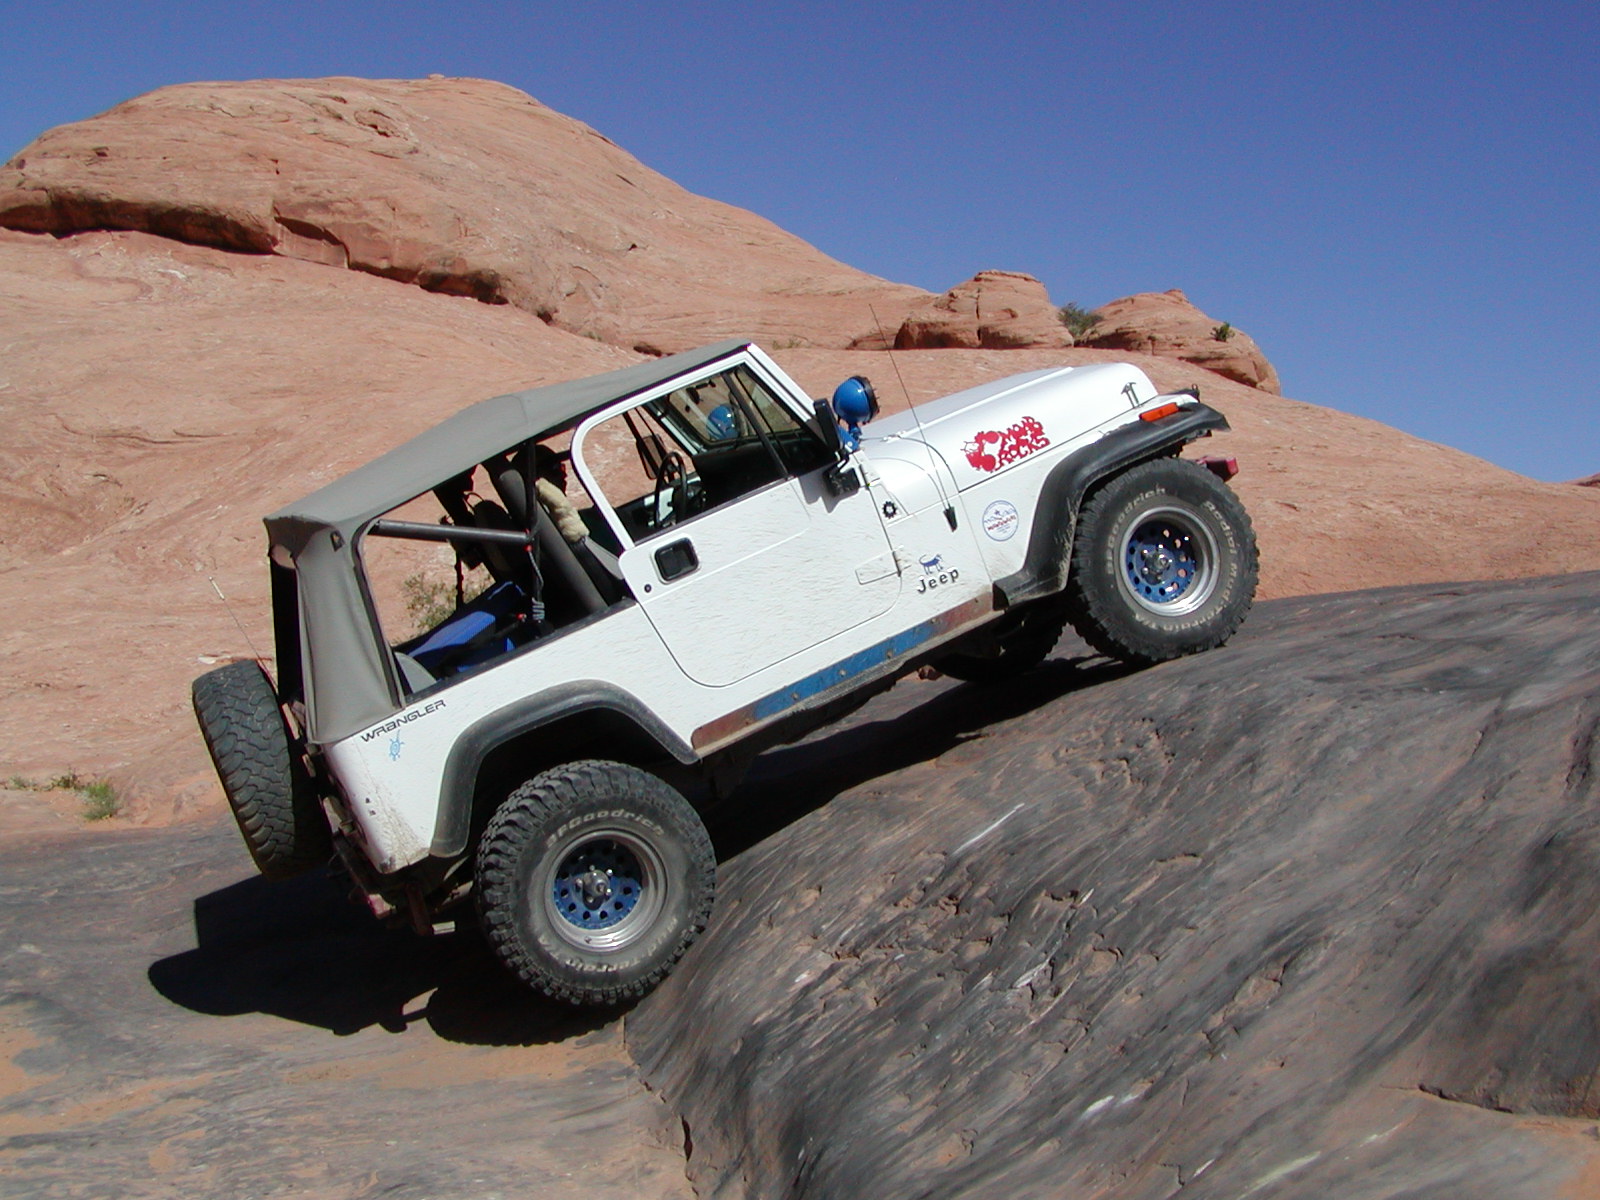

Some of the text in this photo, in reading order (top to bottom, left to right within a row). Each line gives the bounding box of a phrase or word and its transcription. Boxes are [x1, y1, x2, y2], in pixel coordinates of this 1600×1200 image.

[994, 437, 1051, 471] ROCKS
[1204, 501, 1237, 554] Radial
[917, 568, 959, 594] Jeep
[361, 699, 447, 742] WRANGLER
[546, 808, 664, 849] BFGoodrich
